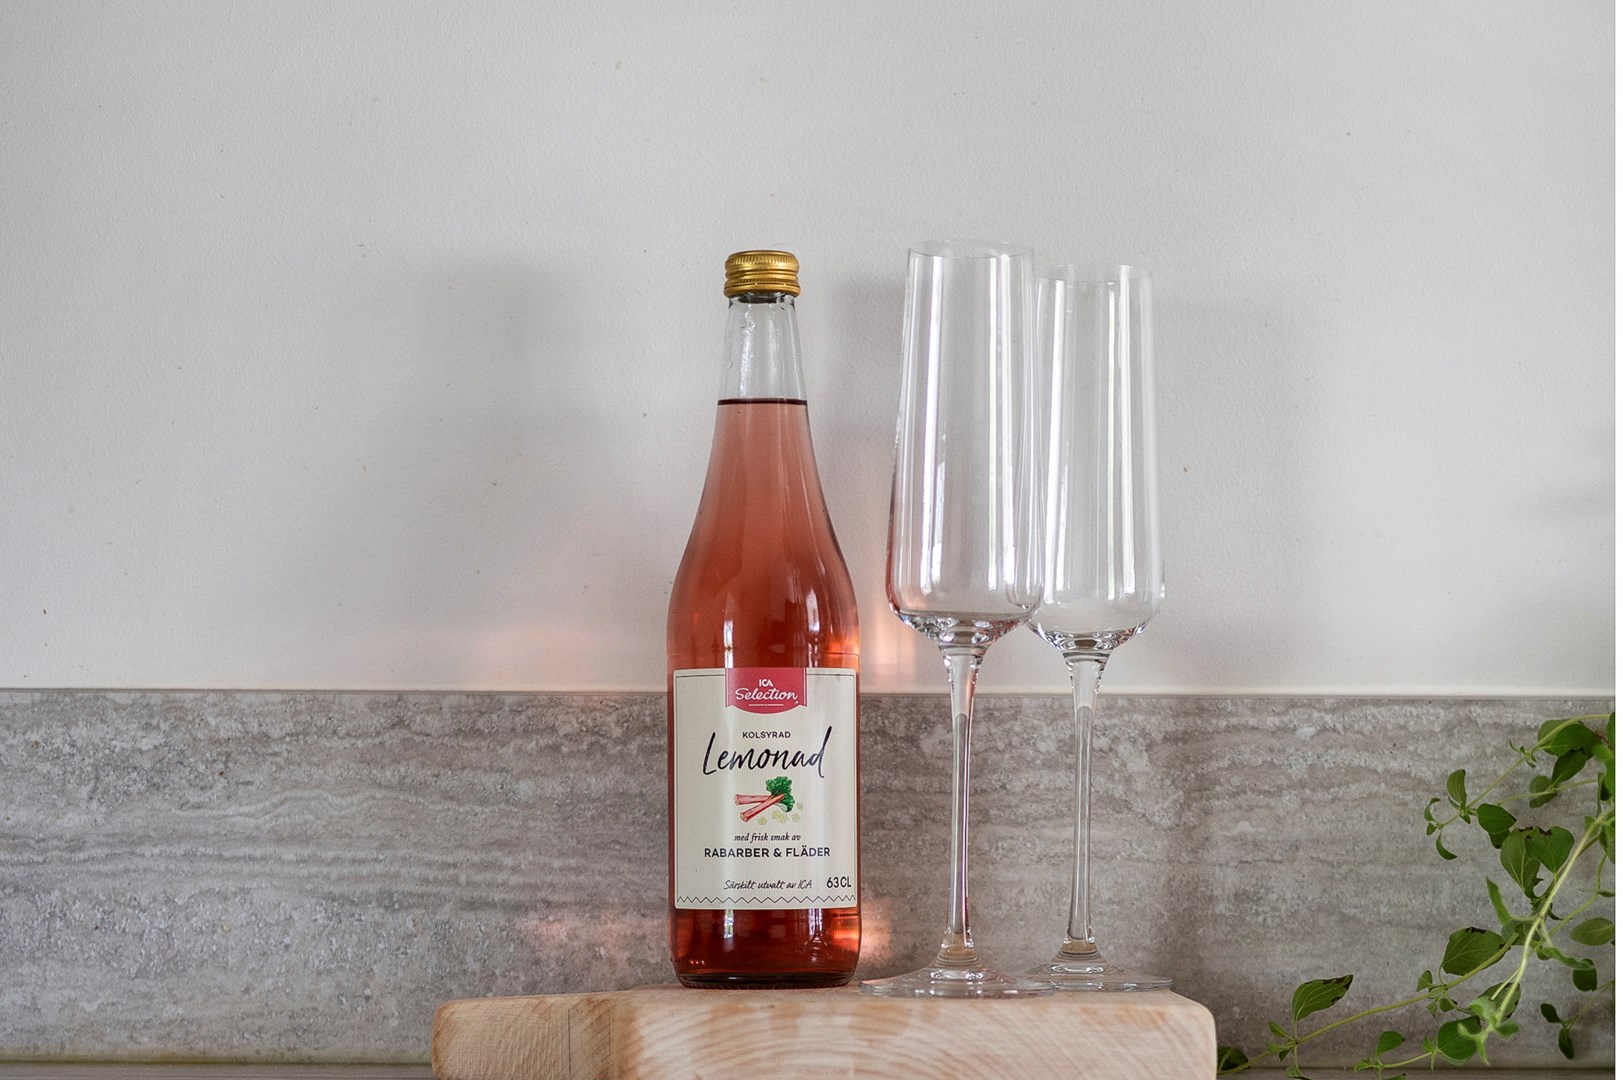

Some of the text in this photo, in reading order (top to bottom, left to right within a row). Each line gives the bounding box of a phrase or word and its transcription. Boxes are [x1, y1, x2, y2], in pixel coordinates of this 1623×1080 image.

[759, 679, 773, 687] ICA
[735, 687, 798, 702] Selection
[743, 731, 791, 739] KOLSYRAD
[703, 726, 832, 778] Lemonad
[734, 833, 749, 841] med
[750, 833, 768, 843] frisk
[771, 833, 790, 841] smak
[705, 845, 830, 858] RABARBER & FLÄDER
[758, 880, 785, 889] utvalt
[798, 880, 812, 889] ICA
